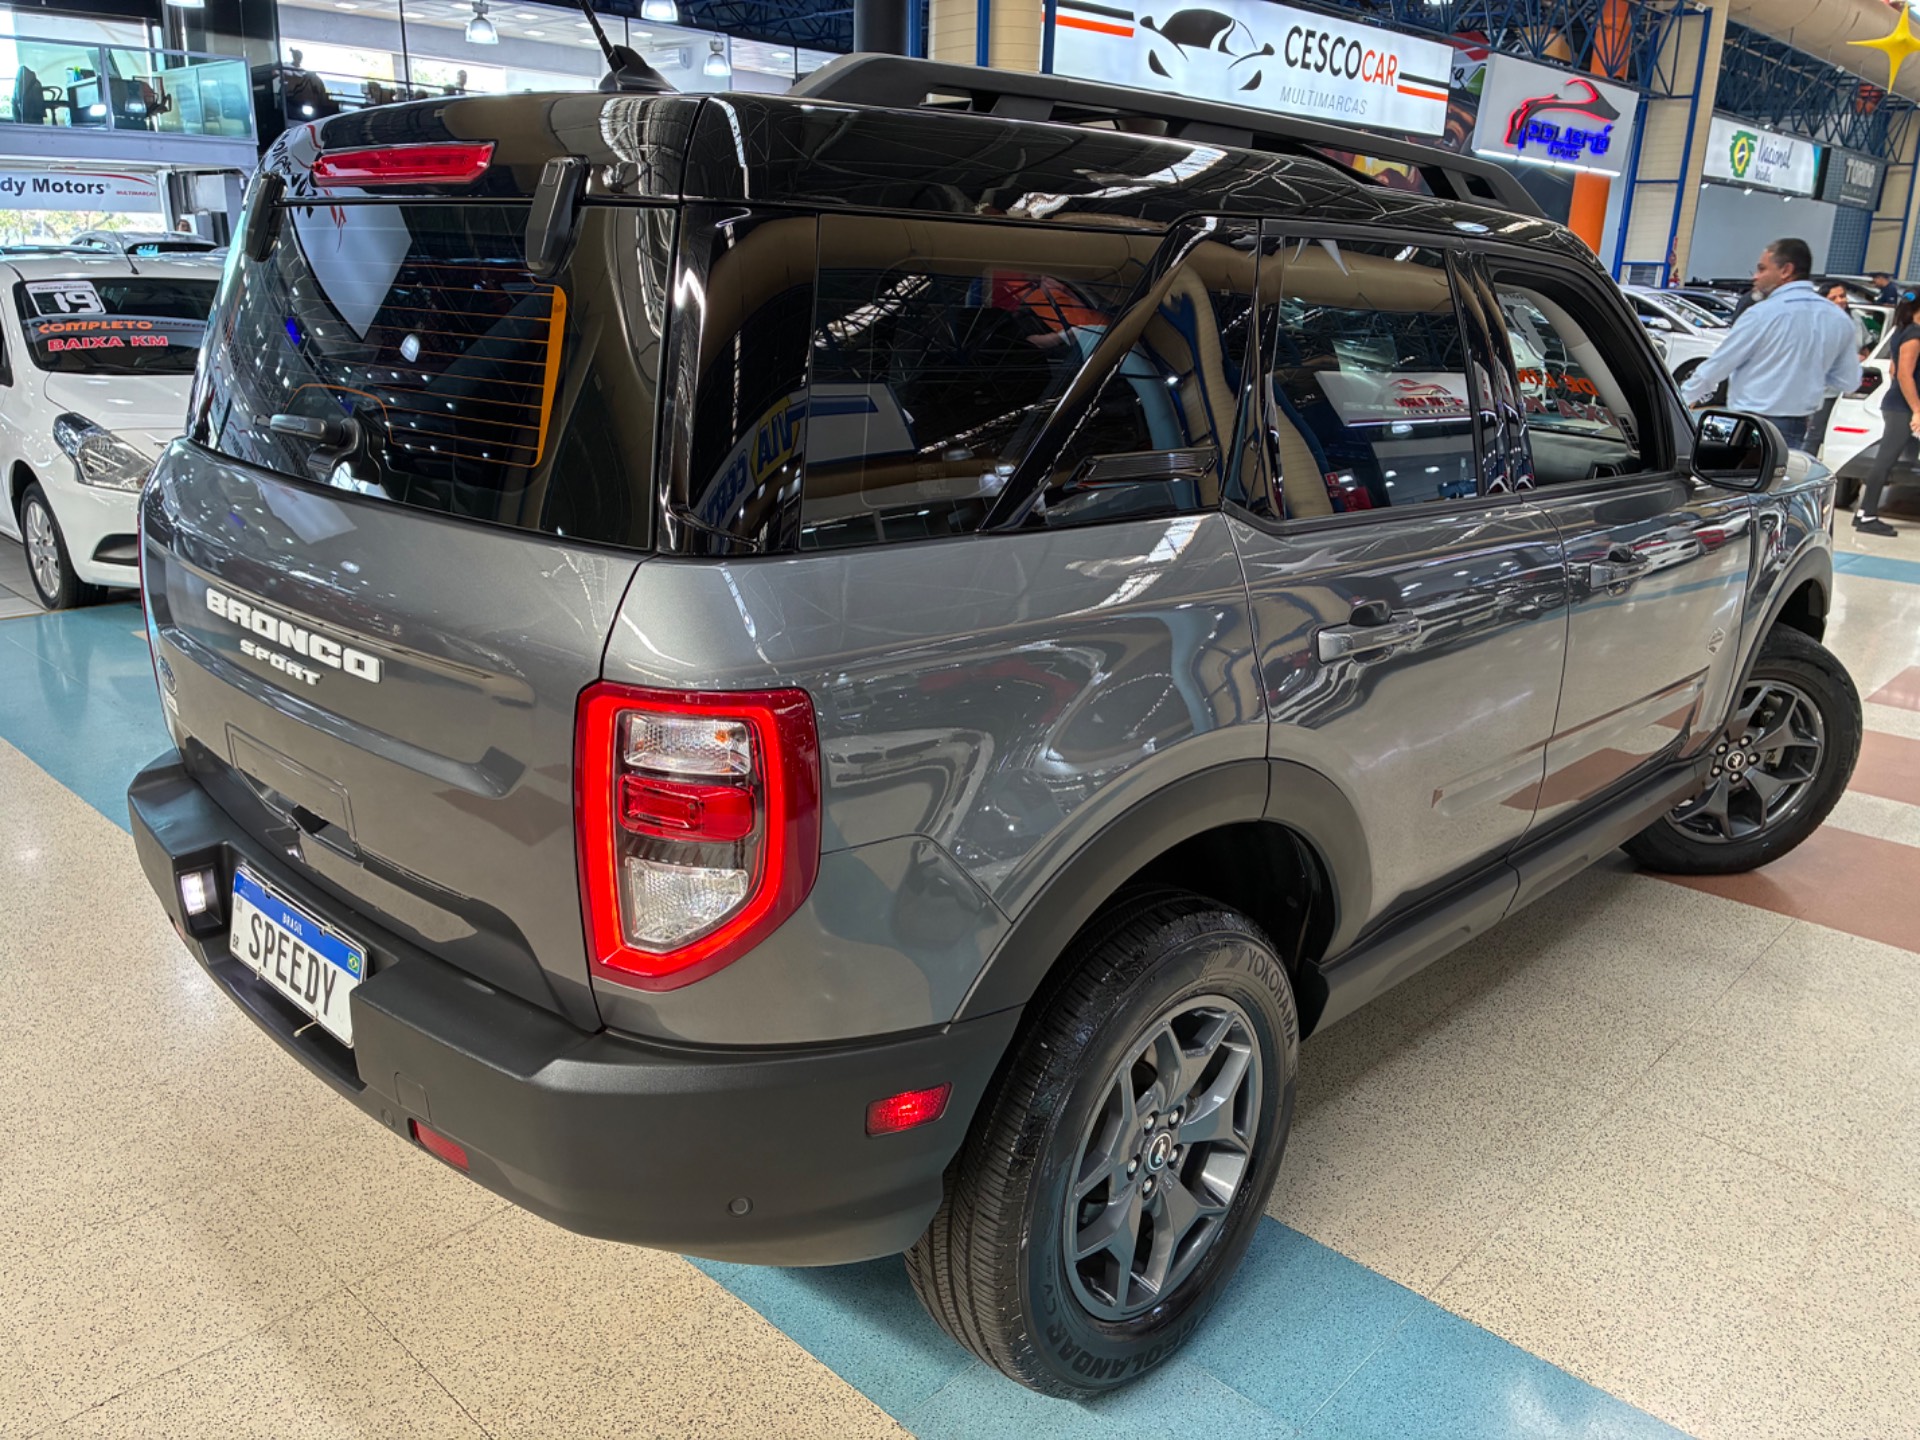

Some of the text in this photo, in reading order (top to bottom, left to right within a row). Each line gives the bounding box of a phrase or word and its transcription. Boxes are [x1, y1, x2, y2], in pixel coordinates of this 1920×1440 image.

[1284, 25, 1398, 87] CESCOCAR
[1280, 85, 1368, 116] MULTIMARCAS
[33, 178, 105, 195] Motors
[53, 291, 102, 313] 19
[38, 320, 153, 334] COMPLETO
[48, 335, 168, 352] BAIXA KM
[206, 587, 382, 684] BRONCO
[240, 639, 323, 686] SPORT
[281, 912, 304, 937] BRASIL
[249, 912, 337, 1017] SPEEDY
[1246, 948, 1297, 1051] YOKOHAMA
